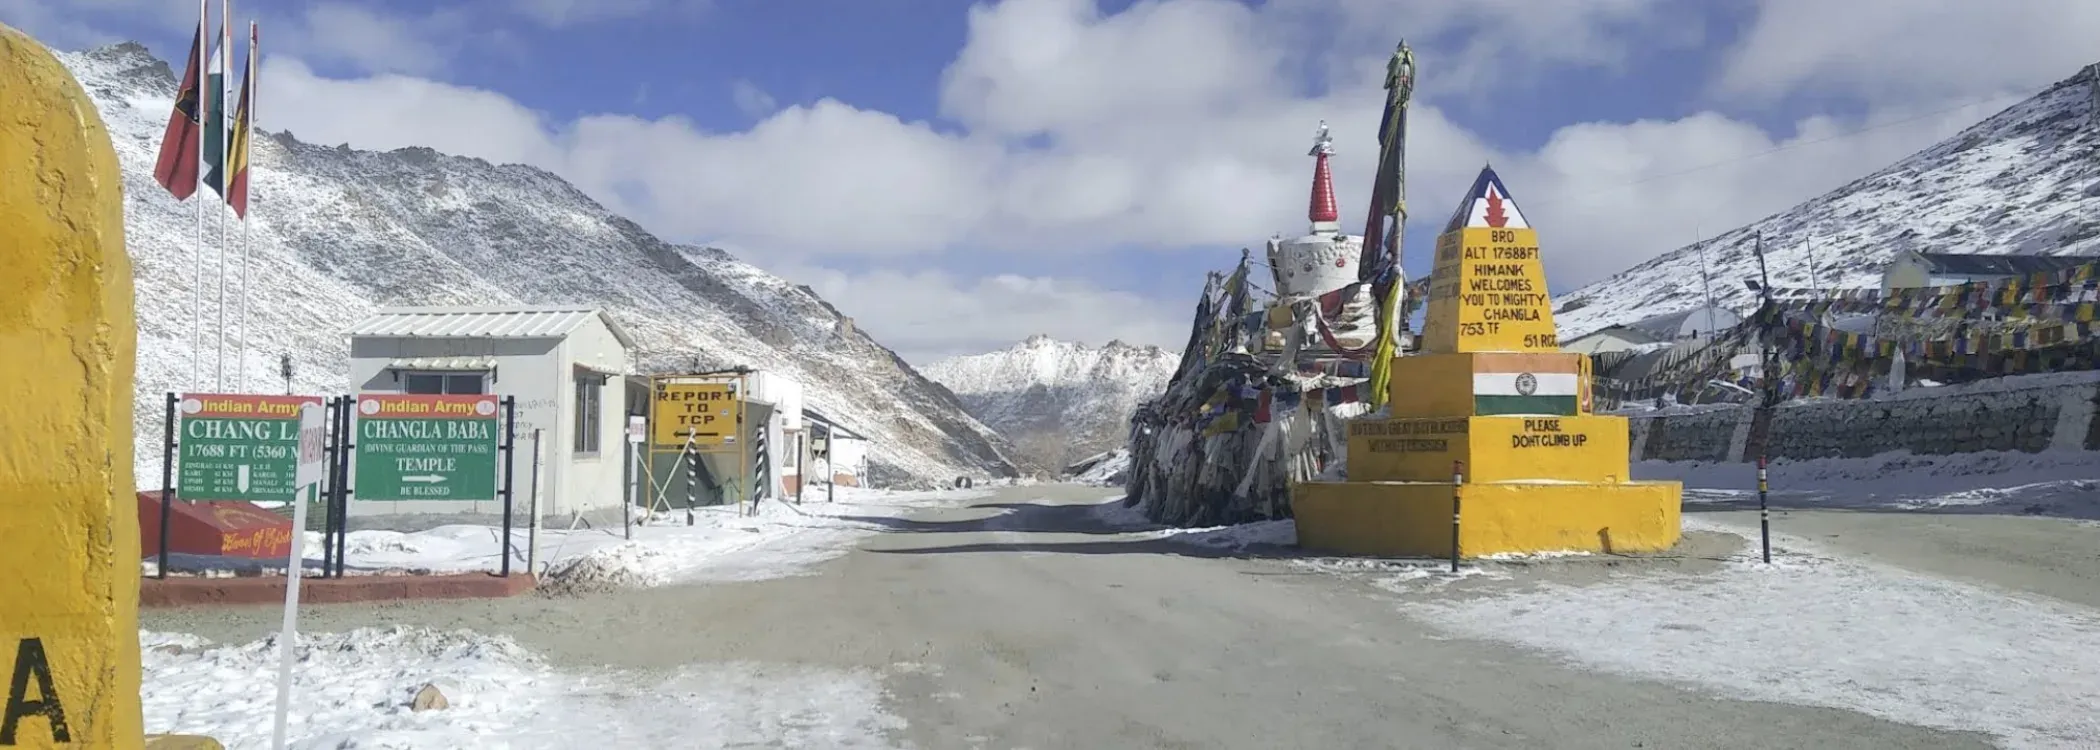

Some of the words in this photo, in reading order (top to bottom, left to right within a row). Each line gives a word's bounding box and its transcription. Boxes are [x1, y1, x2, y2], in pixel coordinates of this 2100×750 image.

[1492, 231, 1515, 243] BRO
[1464, 246, 1487, 260] ALT
[1474, 265, 1524, 276] HIMANK
[1469, 279, 1532, 291] WELCOMES
[1461, 294, 1485, 306] YOU
[1488, 294, 1500, 305] TO
[1503, 294, 1546, 306] MIGHTY
[1483, 308, 1541, 321] CHANGLA
[1460, 323, 1485, 336] 753
[1488, 322, 1500, 333] TF
[1523, 334, 1538, 348] 51
[658, 391, 735, 401] REPORT
[203, 400, 253, 413] Indian
[257, 400, 300, 417] Army
[381, 400, 429, 413] Indian
[434, 400, 476, 416] Army
[684, 403, 709, 413] TO
[678, 415, 715, 425] TCP
[1524, 420, 1561, 432] PLEASE
[188, 419, 271, 441] CHANG
[364, 420, 442, 440] CHANGLA
[447, 420, 489, 440] BABA
[1541, 434, 1570, 447] CLIMB
[1572, 433, 1587, 447] UP
[188, 444, 225, 458] 17688
[228, 444, 249, 458] FT
[252, 445, 286, 460] (5360
[365, 443, 393, 453] (DIVINE
[395, 443, 436, 453] GUARDIAN
[437, 443, 449, 453] OF
[450, 444, 466, 453] THE
[396, 457, 456, 471] TEMPLE
[400, 486, 412, 496] BE
[413, 486, 450, 496] BLESSED
[0, 637, 71, 745] A
